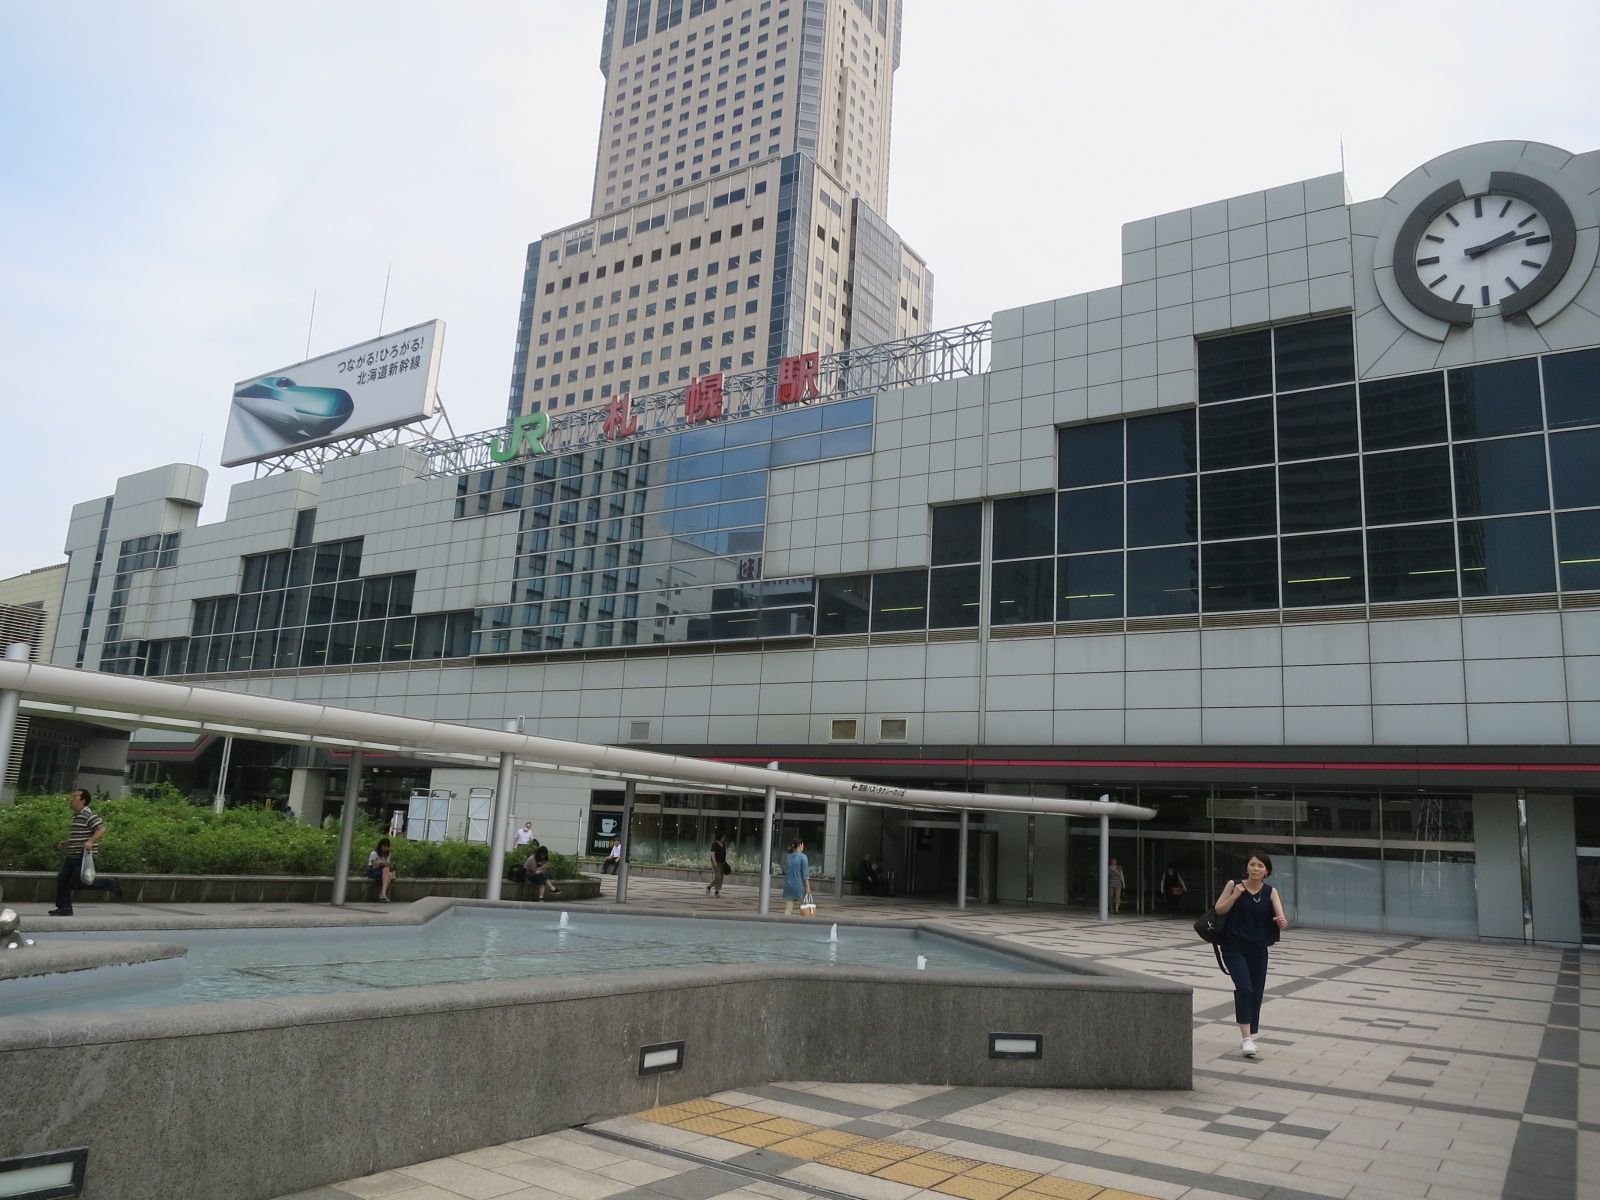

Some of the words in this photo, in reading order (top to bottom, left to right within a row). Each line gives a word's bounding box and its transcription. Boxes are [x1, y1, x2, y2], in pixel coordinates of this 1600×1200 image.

[356, 355, 421, 385] 北海道新幹線
[490, 411, 549, 462] JR
